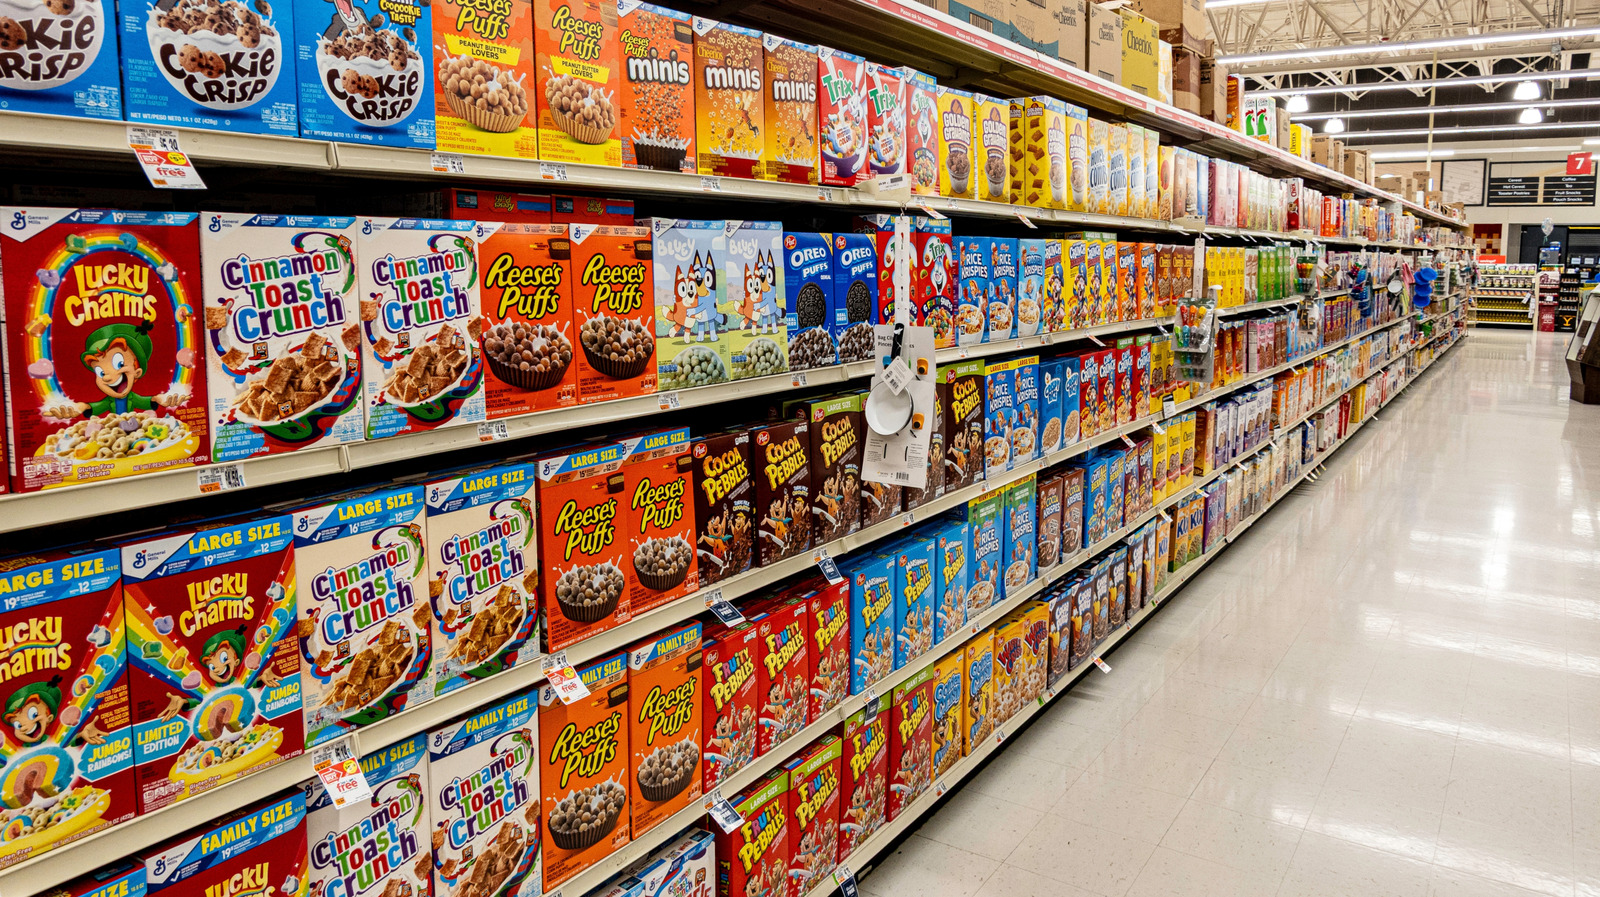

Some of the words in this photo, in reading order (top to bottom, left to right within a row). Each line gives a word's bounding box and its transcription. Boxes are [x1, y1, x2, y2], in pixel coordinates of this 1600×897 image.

[390, 11, 416, 26] TASTE!
[456, 5, 511, 40] Puffs
[552, 5, 604, 39] Reese's
[900, 7, 912, 18] Please
[922, 17, 938, 28] assistance
[459, 40, 483, 50] PEANUT
[484, 44, 507, 54] BUTTER
[559, 30, 602, 61] Puffs
[956, 30, 966, 39] Please
[1126, 29, 1153, 56] Cheerios
[471, 49, 500, 60] LOVERS
[627, 47, 690, 85] minis
[697, 46, 724, 60] Cheerios
[705, 56, 762, 92] minis
[822, 69, 854, 106] Trix
[868, 83, 897, 118] Trix
[156, 167, 187, 177] free
[1574, 157, 1585, 170] 7
[164, 213, 175, 225] 12
[225, 250, 340, 285] Cinnamon
[375, 250, 466, 282] Cinnamon
[485, 253, 563, 288] Reese's
[790, 248, 826, 268] OREO
[802, 262, 829, 278] PUFFS
[841, 248, 872, 267] OREO
[851, 262, 873, 277] PUFFS
[961, 265, 988, 280] KRISPIES
[965, 253, 983, 266] RICE
[1023, 265, 1044, 278] KRISPIES
[73, 263, 150, 298] Lucky
[249, 273, 324, 310] Toast
[394, 271, 454, 303] Toast
[64, 292, 158, 328] Charms
[237, 290, 344, 340] Crunch
[385, 286, 470, 330] Crunch
[498, 285, 560, 319] Puffs
[953, 377, 977, 401] COCOA
[1016, 386, 1038, 405] KRISPIES
[1022, 377, 1035, 389] RICE
[826, 402, 841, 412] LARGE
[841, 400, 851, 410] SIZE
[951, 389, 981, 425] PEBBLES
[821, 415, 853, 442] COCOA
[571, 452, 598, 469] LARGE
[600, 448, 618, 461] SIZE
[702, 447, 743, 479] COCOA
[820, 429, 857, 469] PEBBLES
[77, 464, 99, 474] Gluten
[99, 462, 115, 470] Free
[77, 472, 87, 481] Sin
[87, 469, 111, 479] Gluten
[462, 475, 498, 494] LARGE
[501, 469, 525, 485] SIZE
[701, 461, 750, 507] PEBBLES
[338, 499, 383, 521] LARGE
[386, 492, 414, 510] SIZE
[554, 497, 618, 537] Reese's
[1043, 501, 1061, 519] KRISPIES
[187, 530, 243, 555] LARGE
[247, 522, 282, 542] SIZE
[443, 516, 521, 562] Cinnamon
[564, 520, 616, 562] Puffs
[61, 557, 105, 582] SIZE
[314, 544, 409, 598] Cinnamon
[459, 537, 510, 576] Toast
[186, 572, 248, 611] Lucky
[335, 567, 397, 613] Toast
[451, 549, 524, 603] Crunch
[861, 591, 893, 626] PEBBLES
[864, 580, 890, 606] FRUITY
[179, 595, 255, 638] Charms
[325, 580, 414, 643] Crunch
[0, 616, 63, 647] ucky
[656, 634, 682, 656] FAMILY
[683, 627, 698, 646] SIZE
[765, 620, 799, 653] FRUITY
[711, 646, 750, 684] FRUITY
[763, 630, 805, 682] PEBBLES
[266, 682, 300, 704] JUMBO
[561, 682, 578, 693] free
[709, 657, 754, 713] PEBBLES
[905, 677, 918, 692] GIANT
[918, 671, 928, 684] SIZE
[265, 692, 301, 713] RAINBOWS!
[465, 708, 505, 734] FAMILY
[506, 697, 529, 718] SIZE
[639, 675, 697, 724] Reese's
[137, 721, 184, 746] LIMITED
[550, 711, 622, 766] Reese's
[647, 698, 694, 747] Puffs
[88, 736, 131, 763] JUMBO
[143, 735, 180, 755] EDITION
[87, 750, 132, 774] RAINBOWS!
[442, 745, 525, 807] Cinnamon
[560, 735, 619, 790] Puffs
[336, 779, 359, 793] free
[459, 769, 514, 819] Toast
[749, 790, 767, 810] LARGE
[767, 784, 779, 797] SIZE
[201, 818, 257, 855] FAMILY
[261, 800, 294, 828] SIZE
[451, 778, 529, 847] Crunch
[740, 798, 780, 843] FRUITY
[738, 810, 786, 874] PEBBLES
